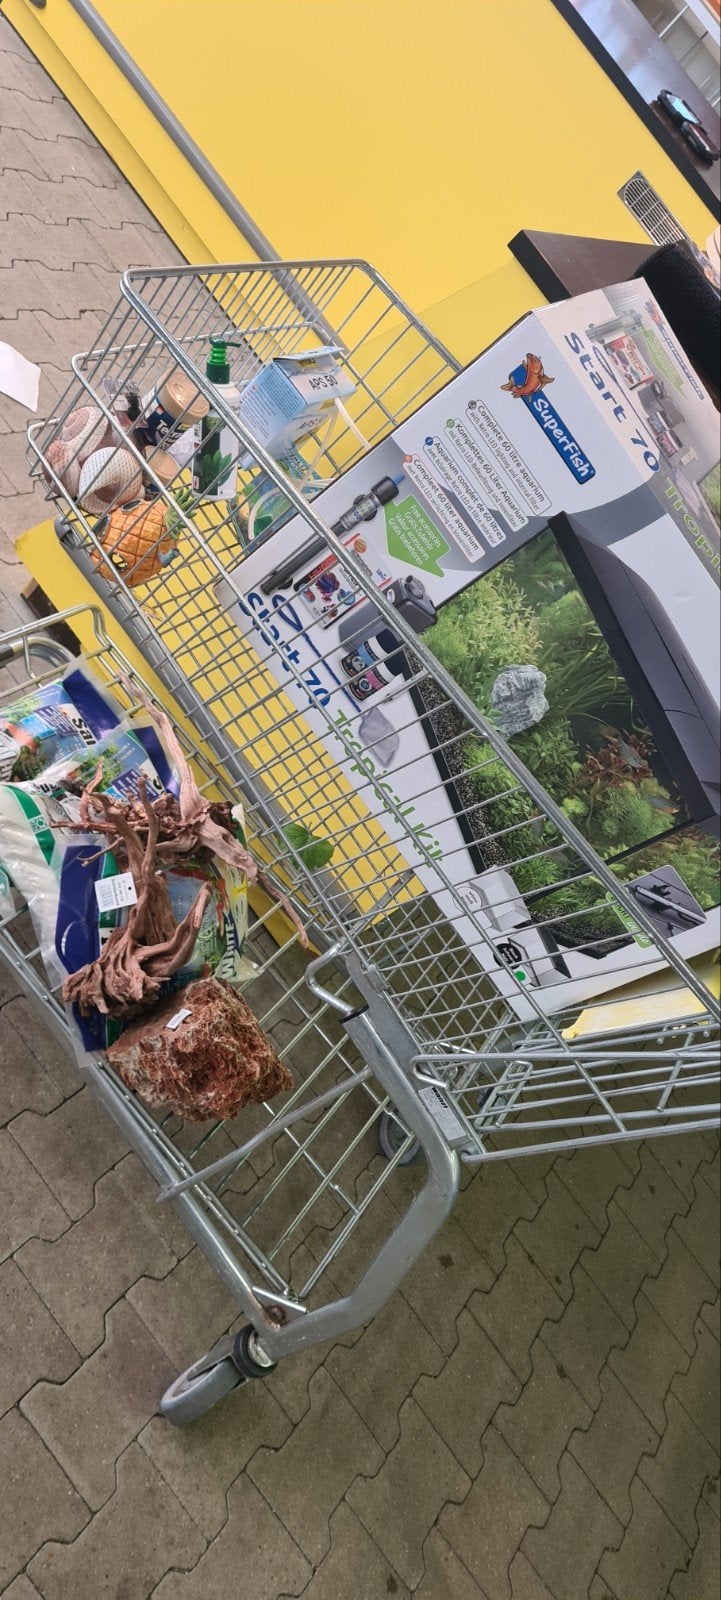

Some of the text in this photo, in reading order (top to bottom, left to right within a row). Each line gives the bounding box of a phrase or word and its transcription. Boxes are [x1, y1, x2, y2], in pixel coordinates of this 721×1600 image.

[308, 374, 339, 390] APS 50
[564, 331, 660, 472] Start 70
[453, 423, 527, 524] Komplettes 60 Liter Aquarium
[475, 405, 545, 503] Complete 60 litre aquarium
[487, 437, 498, 449] LED
[534, 398, 593, 478] SuperFish
[409, 504, 442, 548] Free accessories
[411, 458, 480, 551] Compleet 60 liter aquarium
[432, 441, 505, 540] Aquarium complet de 60 litres
[297, 667, 331, 709] 70
